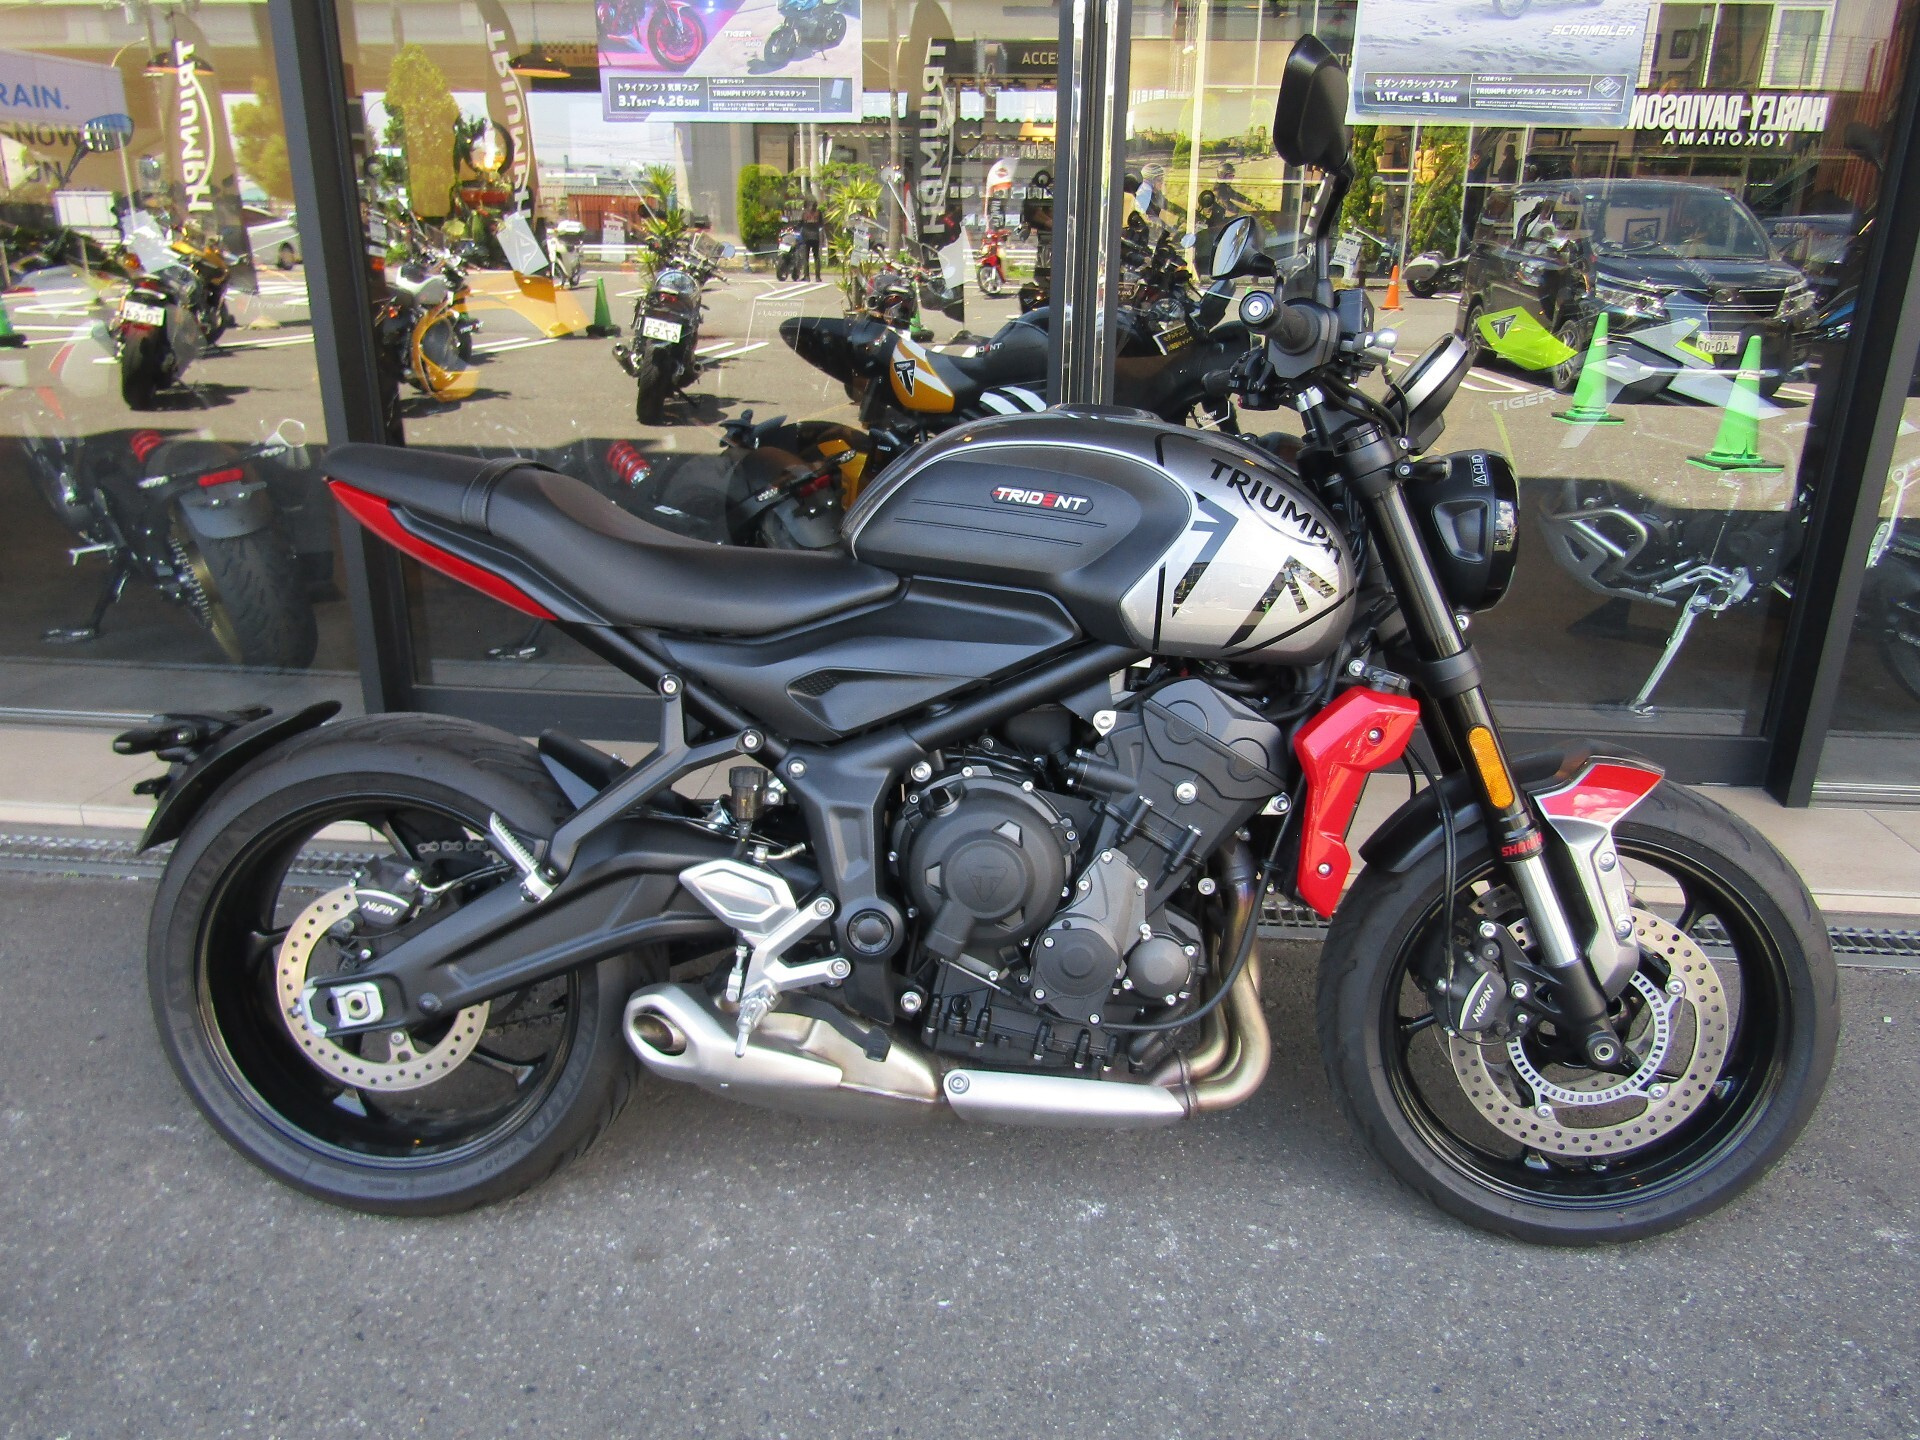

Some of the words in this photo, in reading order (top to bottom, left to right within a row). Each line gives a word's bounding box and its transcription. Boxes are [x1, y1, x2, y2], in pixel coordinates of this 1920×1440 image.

[1551, 24, 1637, 36] SCRAMBLER
[1021, 52, 1058, 65] ACCE
[1487, 389, 1557, 411] TIGER
[995, 486, 1088, 511] TRIDENT
[1209, 458, 1343, 566] TRIUMPH
